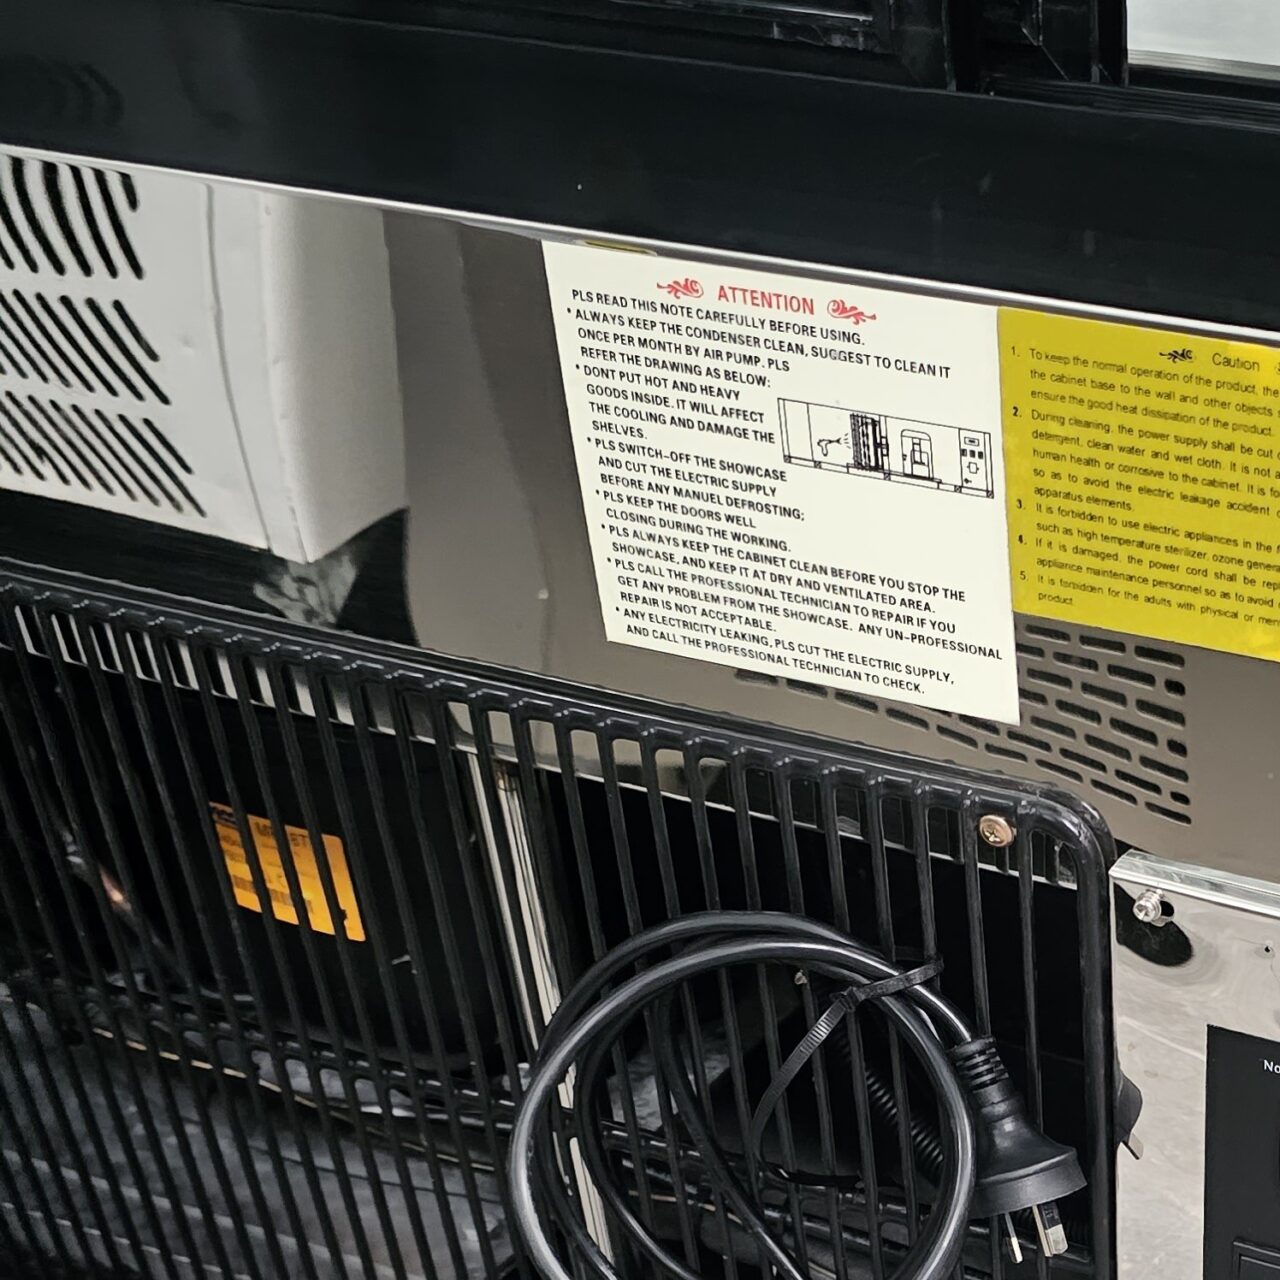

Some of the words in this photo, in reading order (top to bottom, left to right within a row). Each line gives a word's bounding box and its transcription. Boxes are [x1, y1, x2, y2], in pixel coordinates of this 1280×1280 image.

[571, 288, 594, 303] PLS
[595, 291, 629, 309] READ
[629, 297, 659, 313] THIS
[659, 301, 694, 320] NOTE
[695, 307, 767, 330] CAREFULLY
[768, 319, 818, 339] BEFORE
[819, 327, 866, 346] USING.
[717, 284, 815, 316] ATTENTION
[575, 308, 626, 327] ALWAYS
[627, 316, 658, 332] KEEP
[658, 320, 684, 337] THE
[684, 325, 762, 349] CONDENSER
[763, 337, 809, 358] CLEAN,
[810, 345, 872, 367] SUGGEST
[872, 354, 892, 370] TO
[893, 358, 937, 377] CLEAN
[938, 365, 951, 380] IT
[577, 326, 611, 344] ONCE
[612, 332, 636, 348] PER
[637, 336, 683, 355] MONTH
[684, 343, 701, 358] BY
[703, 347, 724, 362] AIR
[725, 350, 765, 369] PUMP.
[766, 357, 791, 373] PLS
[579, 345, 618, 363] REFER
[617, 351, 643, 367] THE
[643, 355, 703, 377] DRAWING
[704, 366, 722, 380] AS
[723, 368, 771, 389] BELOW:
[1211, 351, 1261, 372] Caution
[583, 364, 617, 381] DONT
[618, 370, 642, 385] PUT
[643, 374, 669, 390] HOT
[671, 379, 698, 394] AND
[699, 384, 741, 401] HEAVY
[585, 382, 629, 401] GOODS
[630, 390, 675, 409] INSIDE.
[675, 398, 687, 411] IT
[688, 400, 719, 417] WILL
[720, 405, 765, 424] AFFECT
[1029, 368, 1047, 382] the
[1049, 372, 1087, 388] cabinet
[1089, 378, 1117, 393] base
[1133, 385, 1152, 398] the
[1154, 390, 1176, 401] wall
[1178, 393, 1199, 406] and
[1202, 397, 1232, 411] other
[1234, 402, 1274, 418] objects
[588, 400, 612, 416] THE
[613, 405, 668, 426] COOLING
[669, 415, 696, 430] AND
[696, 419, 750, 441] DAMAGE
[751, 429, 776, 445] THE
[594, 437, 617, 452] PLS
[617, 441, 692, 465] SWITCH-OFF
[692, 454, 717, 470] THE
[718, 459, 788, 483] SHOWCASE
[599, 472, 645, 492] BEFORE
[646, 481, 671, 496] ANY
[672, 485, 724, 507] MANUEL
[724, 495, 805, 522] DEFROSTING;
[1035, 521, 1061, 534] such
[1076, 527, 1099, 543] high
[1099, 532, 1162, 553] temperature
[1211, 553, 1245, 568] ozone
[1056, 505, 1105, 524] forbidden
[1121, 519, 1141, 531] use
[1142, 521, 1181, 538] electric
[1183, 529, 1240, 548] appliances
[1255, 540, 1273, 554] the
[614, 557, 636, 572] PLS
[636, 562, 666, 578] CALL
[665, 567, 688, 582] THE
[690, 572, 779, 601] PROFESSIONAL
[779, 590, 852, 615] TECHNICIAN
[852, 604, 870, 618] TO
[871, 607, 915, 627] REPAIR
[915, 616, 927, 629] IF
[928, 618, 956, 635] YOU
[626, 623, 650, 638] AND
[651, 628, 679, 644] CALL
[680, 634, 703, 649] THE
[703, 639, 791, 667] PROFESSIONAL
[791, 657, 863, 682] TECHNICIAN
[863, 672, 881, 685] TO
[881, 675, 925, 695] CHECK.
